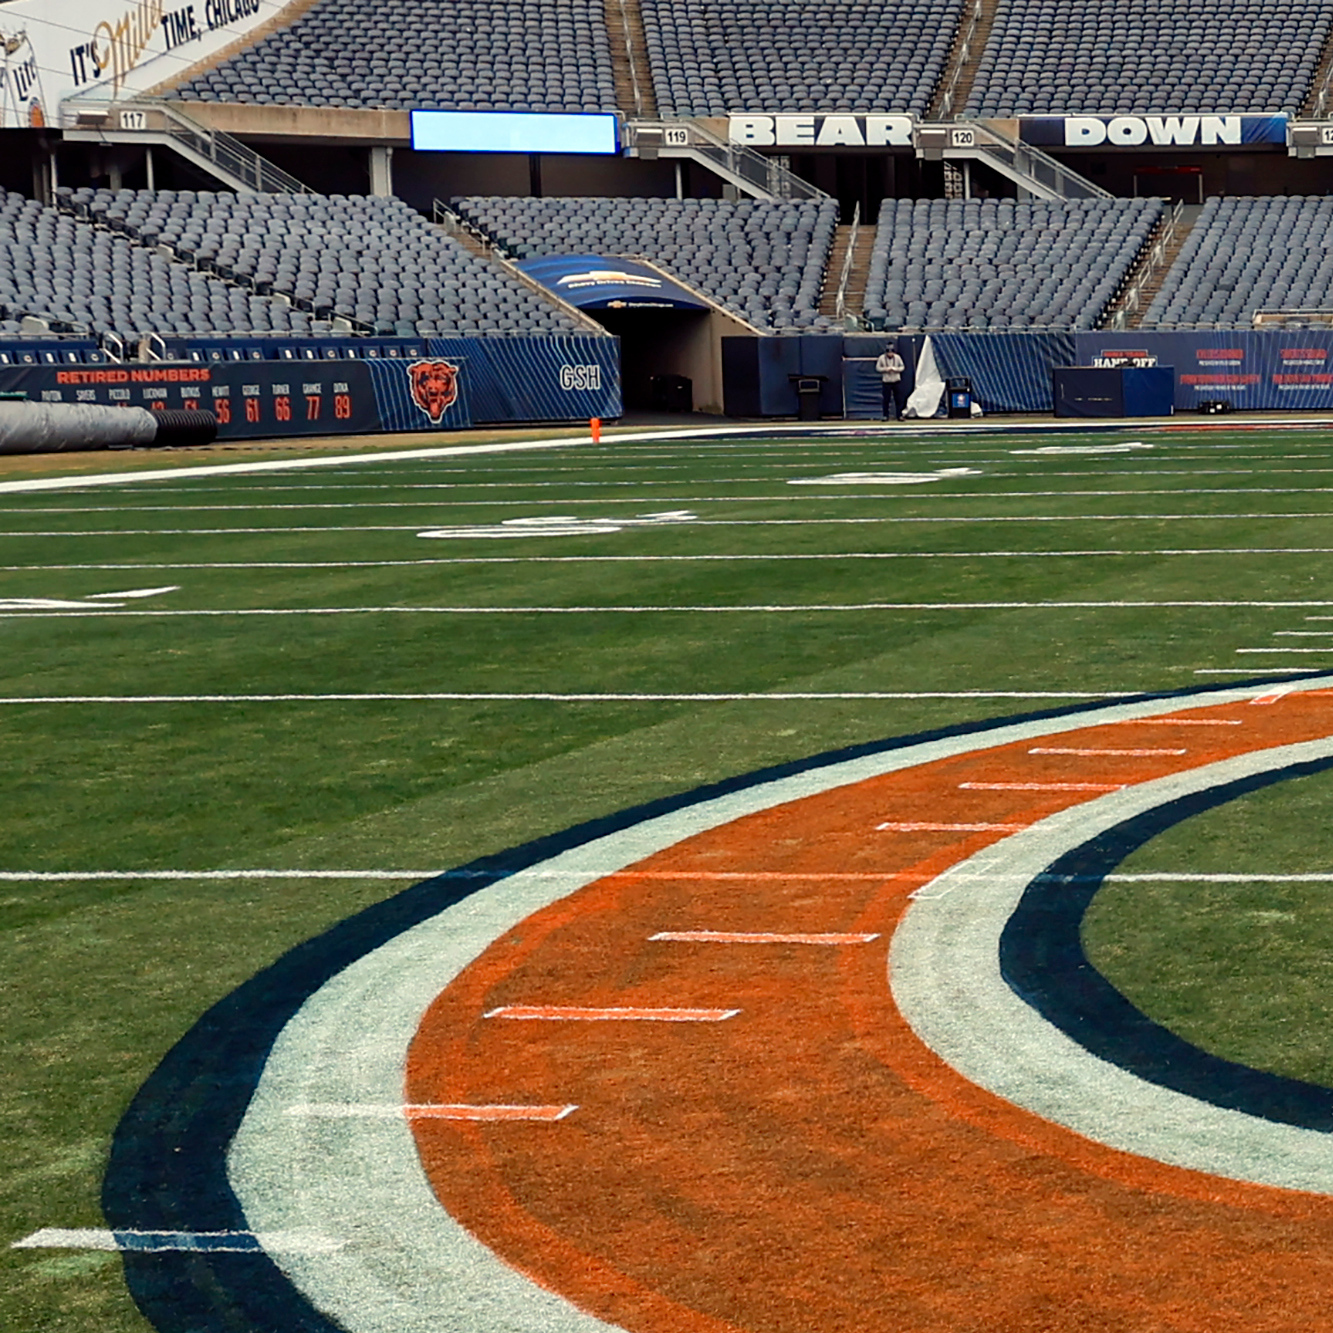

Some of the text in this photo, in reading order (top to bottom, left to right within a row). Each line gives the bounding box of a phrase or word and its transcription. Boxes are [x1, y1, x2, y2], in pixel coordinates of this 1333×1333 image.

[70, 42, 101, 86] IT'S
[160, 5, 202, 50] TIME,
[122, 113, 143, 127] 117
[729, 116, 913, 146] BEAR
[1065, 116, 1241, 145] DOWN
[667, 131, 686, 143] 119
[953, 131, 973, 144] 120
[57, 369, 211, 384] RETIRED NUMBERS
[560, 364, 600, 390] GSH
[245, 398, 260, 422] 61
[275, 396, 291, 421] 66
[305, 396, 320, 420] 77
[335, 395, 351, 419] 89
